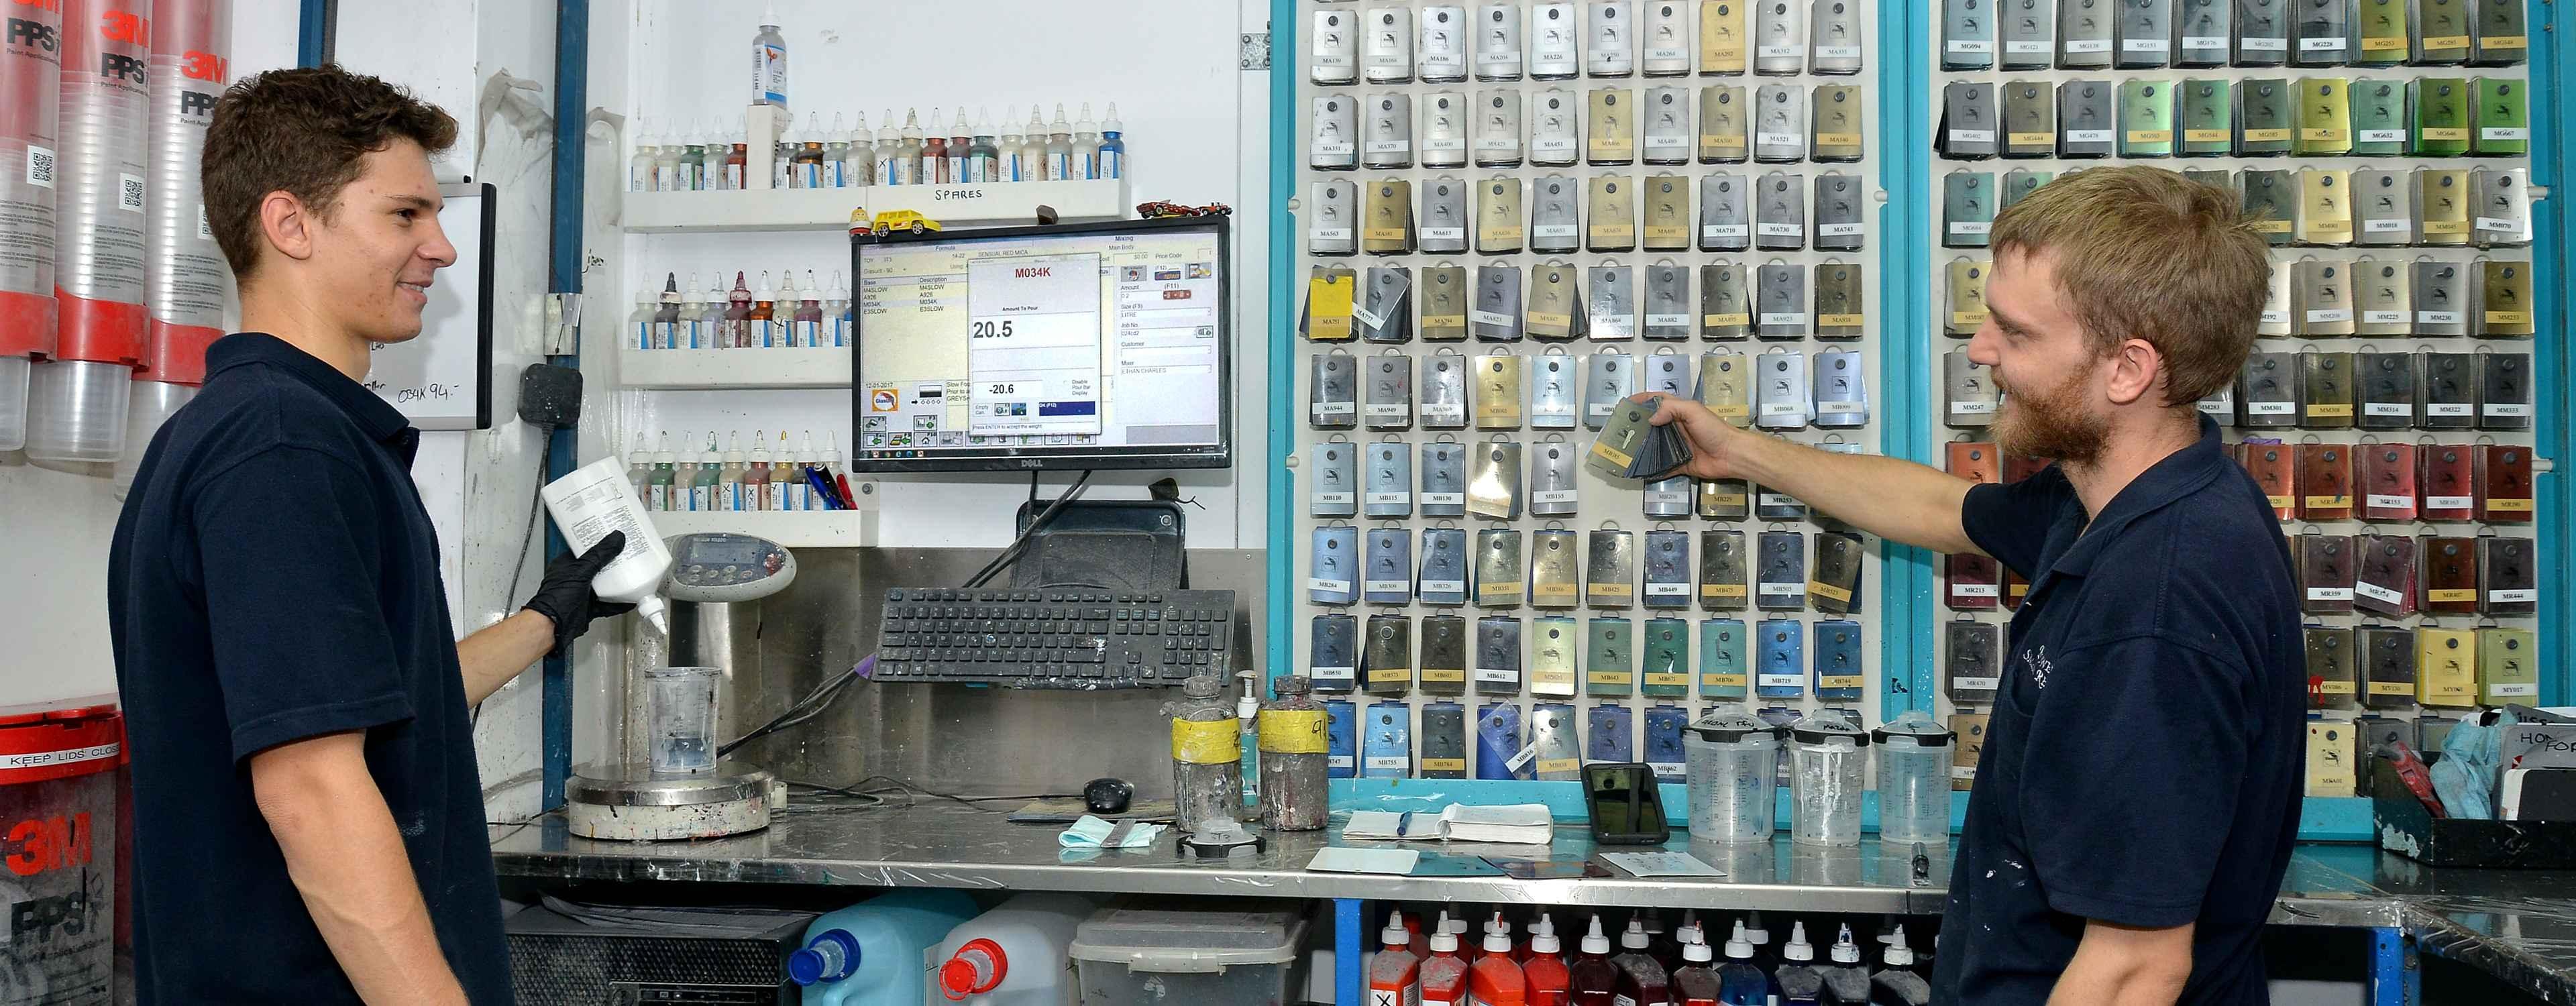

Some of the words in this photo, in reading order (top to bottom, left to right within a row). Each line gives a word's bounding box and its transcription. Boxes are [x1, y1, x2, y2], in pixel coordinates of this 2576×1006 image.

[100, 10, 149, 48] 3M
[101, 52, 145, 84] PPS
[180, 50, 227, 86] 3M
[180, 91, 218, 116] PP
[935, 189, 983, 201] SPARES
[1015, 266, 1051, 278] M034K
[973, 320, 1013, 339] 20.5
[989, 384, 1014, 395] -20.6
[9, 754, 52, 767] KEEP
[58, 748, 85, 761] LIDS
[5, 812, 92, 876] 3M
